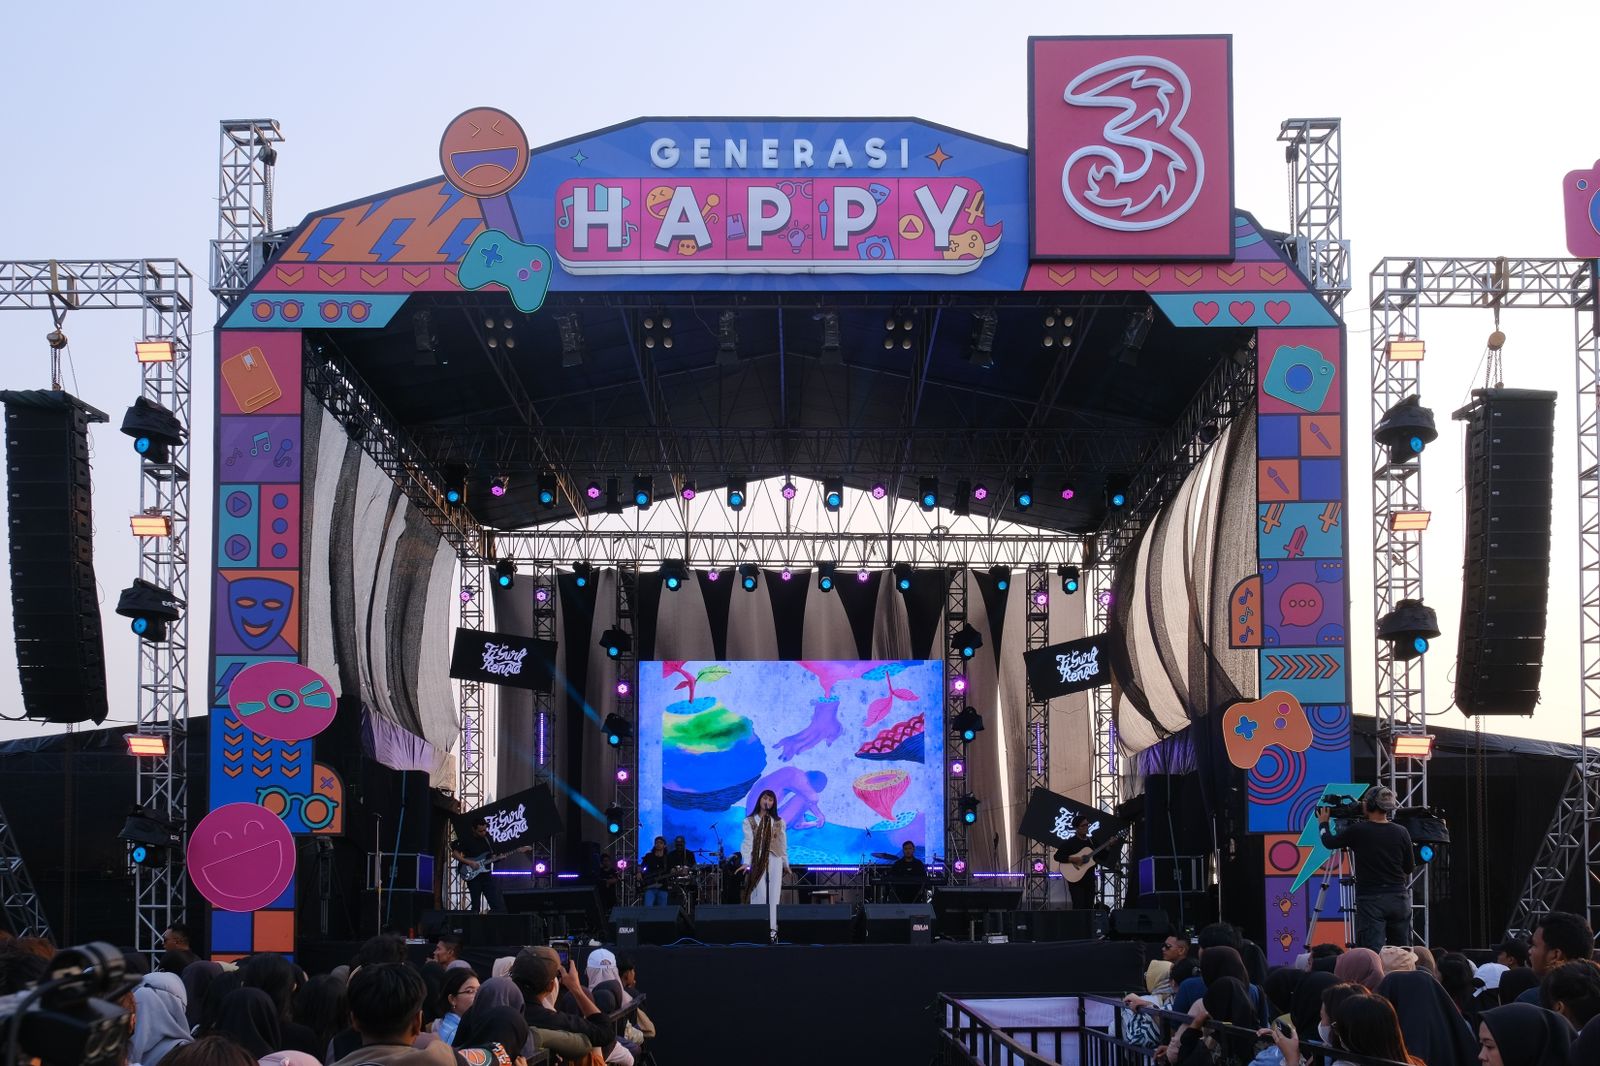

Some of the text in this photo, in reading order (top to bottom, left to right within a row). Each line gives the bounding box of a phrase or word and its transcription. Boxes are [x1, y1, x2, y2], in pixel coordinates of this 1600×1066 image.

[649, 137, 910, 170] GENERASI
[1061, 55, 1206, 232] 3
[572, 183, 968, 252] HAPPY
